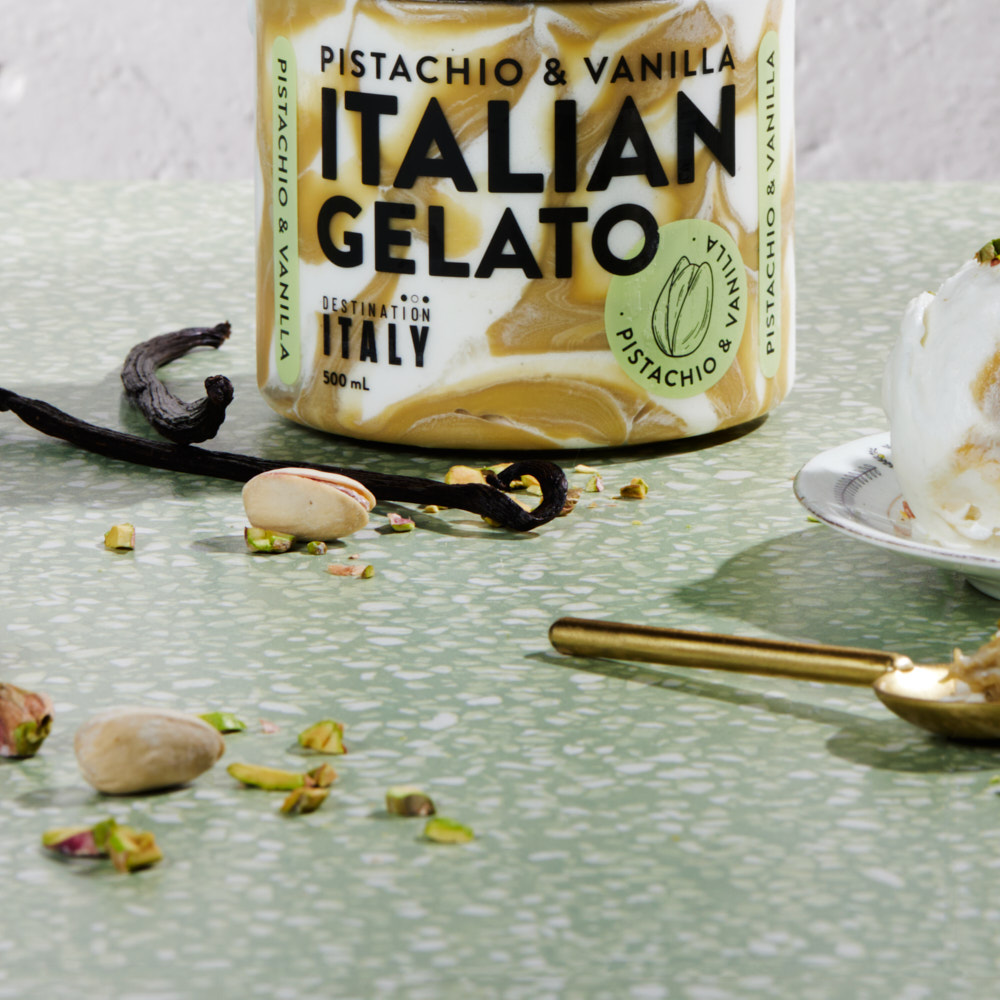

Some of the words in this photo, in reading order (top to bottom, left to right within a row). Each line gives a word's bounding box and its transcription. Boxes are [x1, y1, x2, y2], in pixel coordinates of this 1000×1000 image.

[321, 45, 524, 87] PISTACHIO
[543, 57, 568, 87] &
[583, 44, 736, 85] VANILLA
[277, 57, 288, 207] PISTACHIO
[321, 83, 736, 194] ITALIAN
[766, 50, 775, 172] VANILLA
[766, 179, 775, 196] &
[278, 217, 288, 233] &
[316, 194, 660, 280] GELATO
[279, 244, 290, 362] VANILLA
[322, 295, 430, 322] DESTINATION
[706, 235, 740, 327] VANILLA
[766, 207, 775, 356] PISTACHIO
[322, 313, 430, 368] ITALY
[616, 327, 717, 387] PISTACHIO
[718, 338, 732, 353] &
[323, 370, 347, 388] 500
[350, 376, 370, 391] mL
